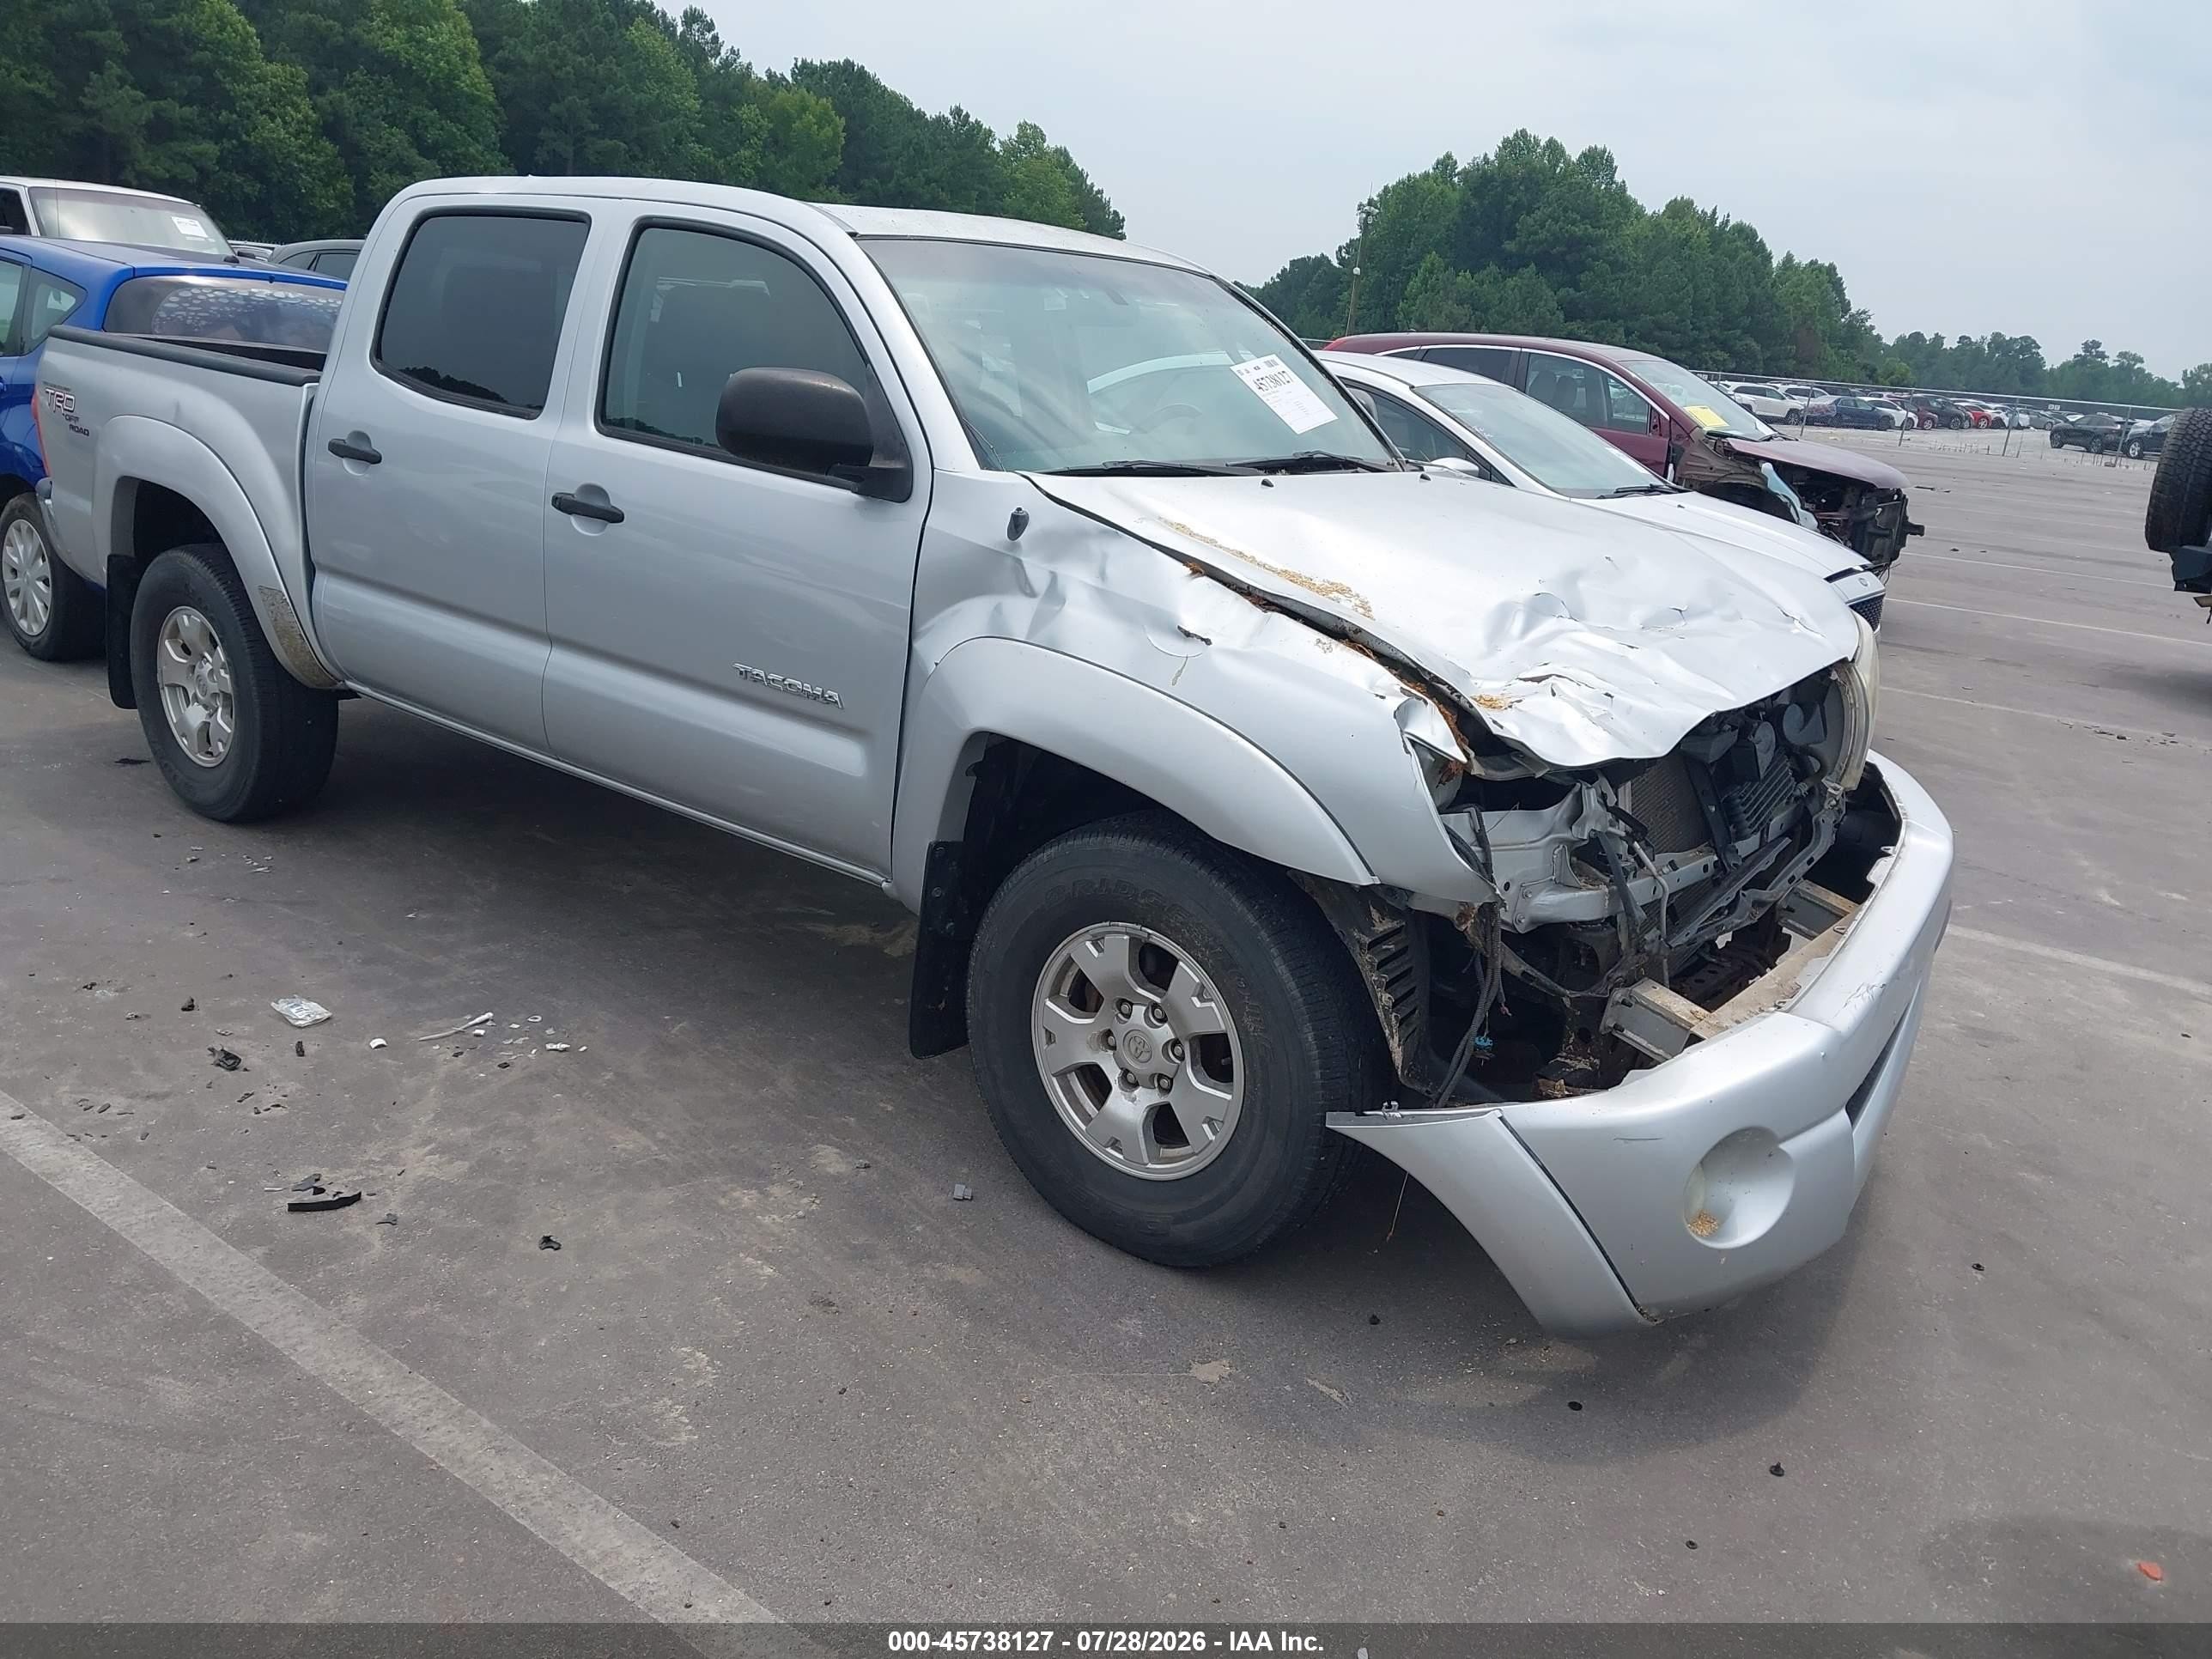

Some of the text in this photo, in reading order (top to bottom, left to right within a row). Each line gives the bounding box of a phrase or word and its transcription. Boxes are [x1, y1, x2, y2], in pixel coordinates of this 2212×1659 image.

[1253, 370, 1293, 392] 45738127
[45, 386, 76, 416] TRD
[64, 414, 80, 423] OFF
[69, 423, 90, 437] ROAD
[732, 663, 844, 708] TACOMA
